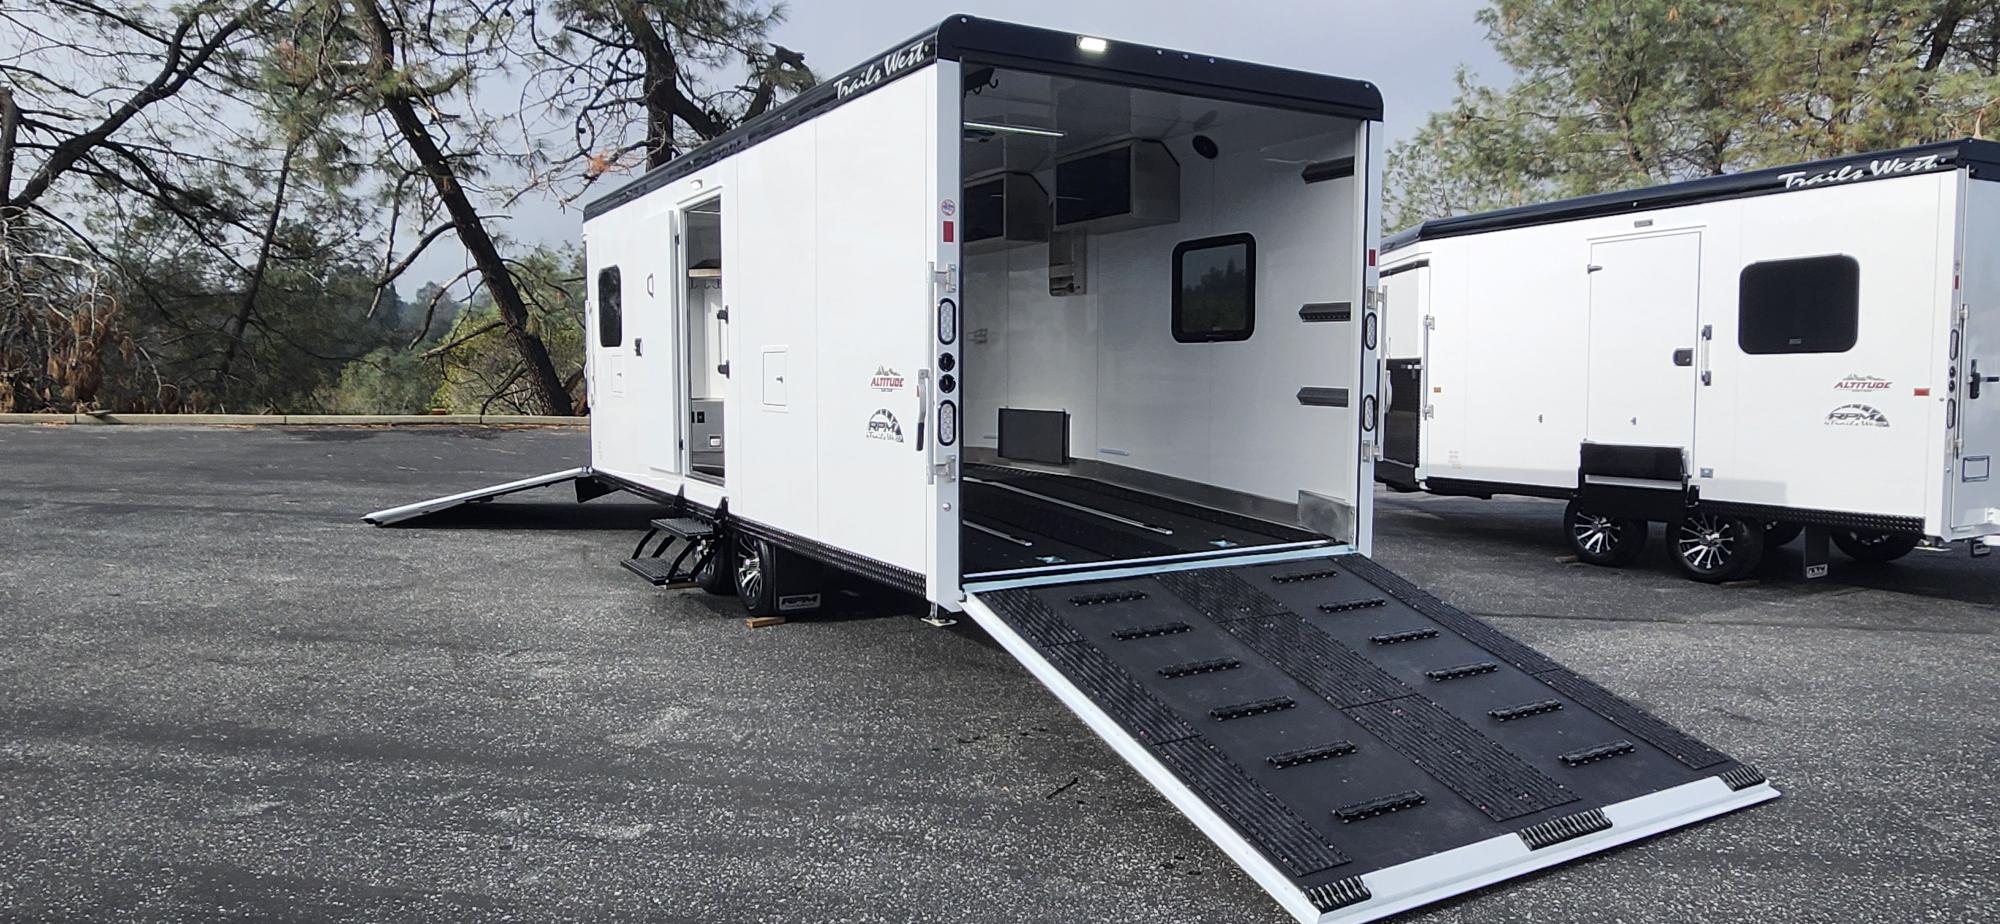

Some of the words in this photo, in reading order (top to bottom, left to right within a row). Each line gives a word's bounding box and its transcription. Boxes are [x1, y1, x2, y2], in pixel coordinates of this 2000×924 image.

[833, 64, 881, 100] Trails
[884, 41, 925, 76] West
[1777, 165, 1864, 189] Trails
[1870, 154, 1938, 176] West
[870, 377, 904, 387] ALTITUDE
[1833, 381, 1893, 389] ALTITUDE
[868, 421, 897, 433] RPM
